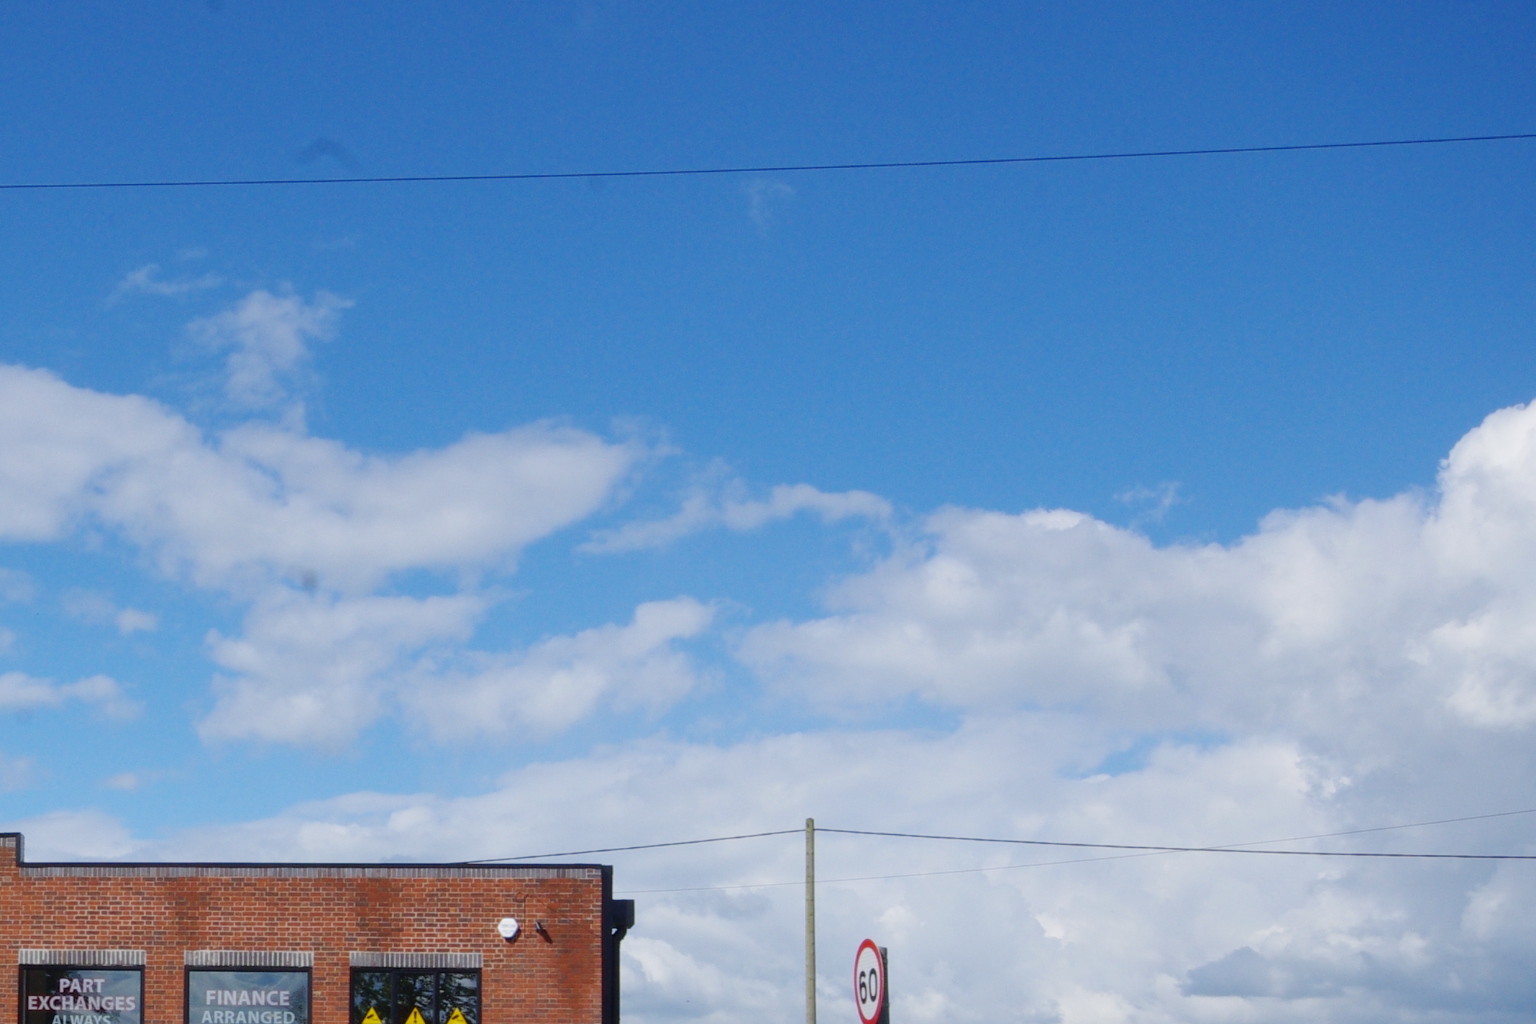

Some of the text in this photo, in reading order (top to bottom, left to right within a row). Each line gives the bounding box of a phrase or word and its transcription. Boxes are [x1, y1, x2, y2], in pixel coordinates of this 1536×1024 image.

[59, 978, 105, 993] PART
[859, 968, 877, 1004] 60
[27, 996, 136, 1011] EXCHANGES
[206, 990, 290, 1006] FINANCE
[201, 1011, 296, 1024] ARRANGED
